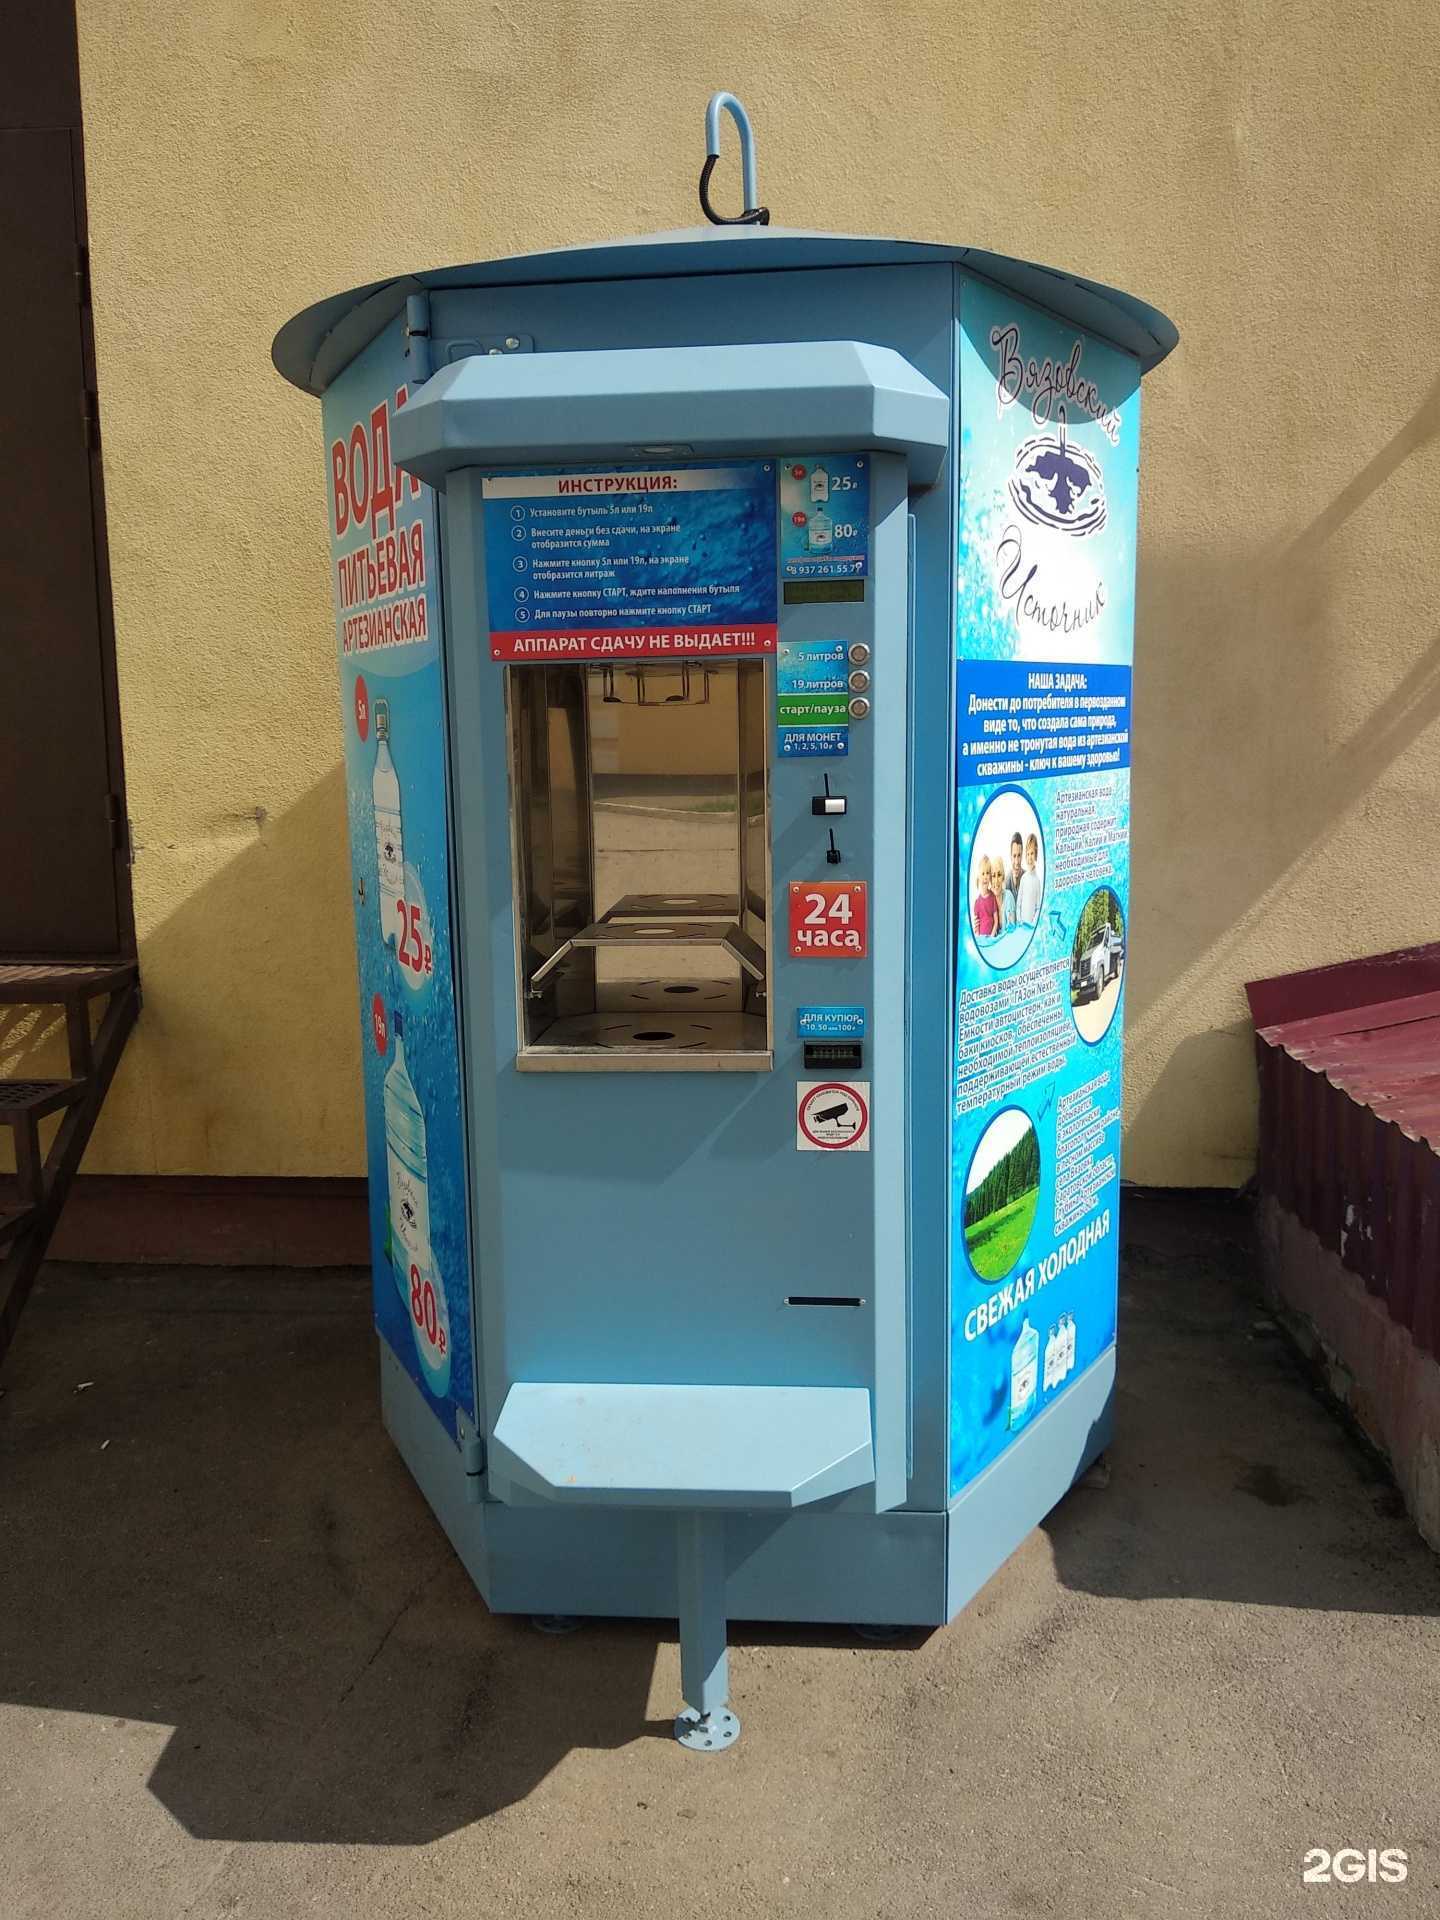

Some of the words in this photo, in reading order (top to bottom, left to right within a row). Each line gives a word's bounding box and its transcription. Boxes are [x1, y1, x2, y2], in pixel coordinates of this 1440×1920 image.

[992, 327, 1119, 443] Вязовский
[558, 475, 678, 494] ИНСТРУКЦИЯ:
[529, 508, 576, 518] Установите
[577, 506, 608, 517] бутыль
[609, 506, 620, 514] 5л
[622, 506, 636, 514] или
[638, 504, 653, 513] 19л
[531, 528, 564, 538] Внесите
[566, 527, 595, 538] деньги
[596, 526, 610, 535] без
[612, 526, 638, 536] сдачи,
[640, 525, 651, 533] на
[651, 524, 681, 535] экране
[531, 539, 582, 550] отобразится
[583, 539, 610, 549] сумма
[338, 523, 426, 609] ПИТЬЕВАЯ
[533, 559, 570, 568] Нажмите
[571, 558, 600, 568] кнопку
[602, 557, 612, 566] 5л
[630, 556, 647, 567] 19л,
[649, 557, 659, 565] на
[660, 556, 689, 566] экране
[799, 566, 817, 575] 937
[817, 565, 834, 574] 261
[837, 565, 848, 574] 55
[533, 570, 583, 581] отобразится
[584, 570, 615, 580] литраж
[996, 524, 1105, 633] Источник
[534, 590, 571, 599] Нажмите
[573, 589, 601, 599] кнопку
[602, 588, 629, 598] СТАРТ,
[630, 587, 656, 597] ждите
[658, 586, 707, 596] наполнения
[709, 584, 740, 595] бутыля
[534, 610, 551, 620] Для
[552, 610, 578, 619] паузы
[579, 609, 617, 618] повторно
[619, 607, 656, 617] нажмите
[658, 607, 686, 616] кнопку
[688, 604, 712, 614] СТАРТ
[342, 596, 427, 653] АРТЕЗИАНСКАЯ
[514, 637, 587, 652] АППАРАТ
[590, 636, 646, 652] СДАЧУ
[649, 634, 670, 648] НЕ
[674, 632, 755, 650] ВЫДАЕТ!!!
[799, 652, 805, 661] 5
[807, 652, 844, 663] литров
[792, 679, 804, 689] 19
[805, 680, 844, 690] литров
[1028, 673, 1053, 689] НАША
[1055, 673, 1088, 692] ЗАДАЧА:
[780, 703, 846, 716] старт/пауза
[968, 694, 1009, 715] Донести
[1010, 696, 1022, 713] до
[1022, 693, 1073, 713] потребителя
[1074, 697, 1079, 708] в
[983, 719, 1007, 735] виде
[1008, 719, 1020, 734] то,
[1021, 718, 1036, 730] что
[1038, 716, 1069, 732] создала
[1070, 715, 1087, 729] сама
[784, 733, 805, 744] ДЛЯ
[807, 732, 841, 742] МОНЕТ
[962, 744, 969, 756] а
[970, 740, 1007, 755] именно
[1008, 740, 1019, 752] не
[1020, 737, 1058, 754] тронутая
[1059, 735, 1077, 750] вода
[1077, 735, 1086, 748] из
[1087, 729, 1128, 749] артезианской
[976, 760, 1024, 776] скважины
[1029, 757, 1052, 771] ключ
[1052, 757, 1058, 769] к
[1058, 754, 1087, 769] вашему
[1087, 748, 1121, 768] здоровью!
[1056, 788, 1097, 804] Артезианская
[1056, 805, 1095, 822] натуральная
[1055, 821, 1089, 840] природная
[804, 893, 853, 926] 24
[797, 929, 861, 948] часа
[960, 985, 996, 1006] Доставка
[998, 981, 1017, 996] воды
[1018, 958, 1071, 986] осуществляется
[804, 1013, 824, 1023] ДЛЯ
[825, 1014, 859, 1022] КУПЮР
[959, 996, 1009, 1024] водовозами
[959, 1022, 993, 1043] Емкости
[958, 1042, 979, 1060] баки
[957, 1046, 1014, 1079] необходимой
[957, 1054, 1031, 1096] поддерживающей
[956, 1074, 1022, 1112] температурный
[1022, 1064, 1047, 1089] режим
[964, 1266, 1036, 1342] СВЕЖАЯ
[1037, 1208, 1111, 1290] ХОЛОДНАЯ
